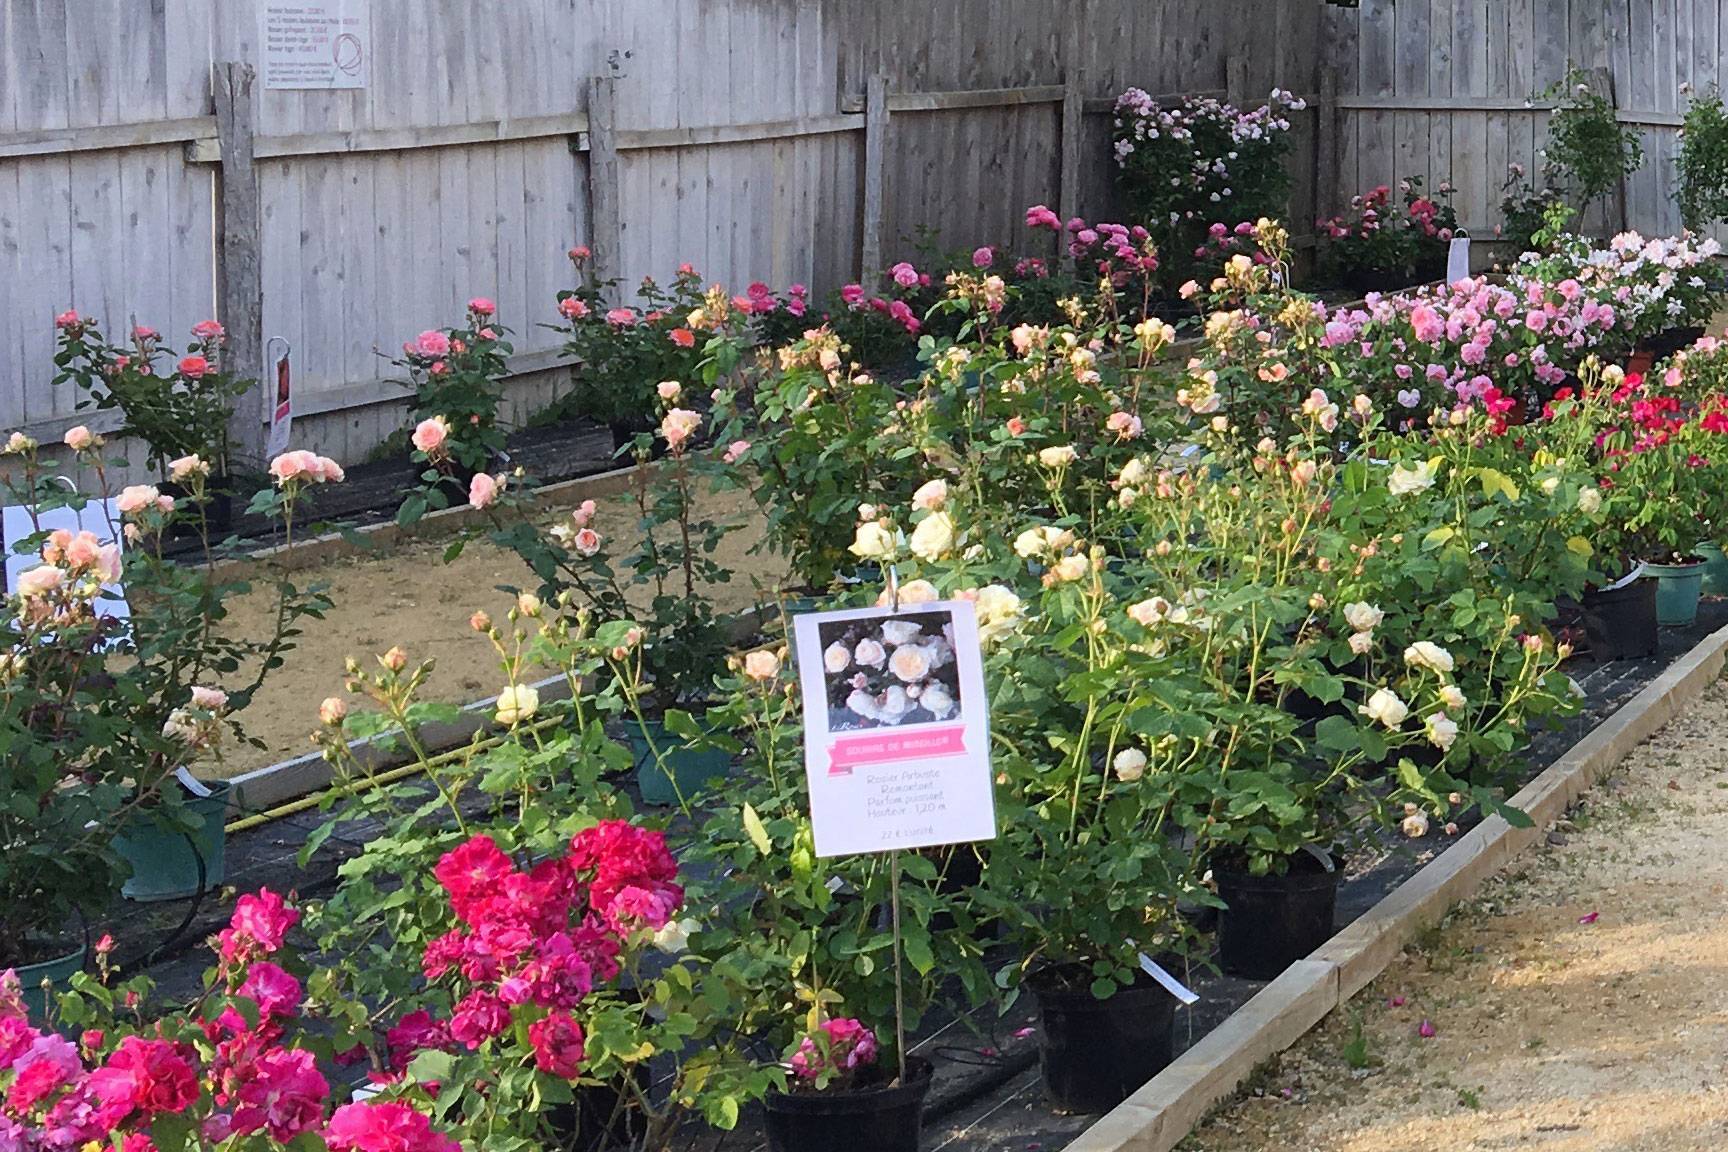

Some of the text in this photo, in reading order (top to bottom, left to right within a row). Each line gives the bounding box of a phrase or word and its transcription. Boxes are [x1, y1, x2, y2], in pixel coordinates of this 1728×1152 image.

[866, 769, 940, 784] Rosier Arbuste
[881, 781, 933, 794] Remontant
[867, 794, 902, 807] Parfum
